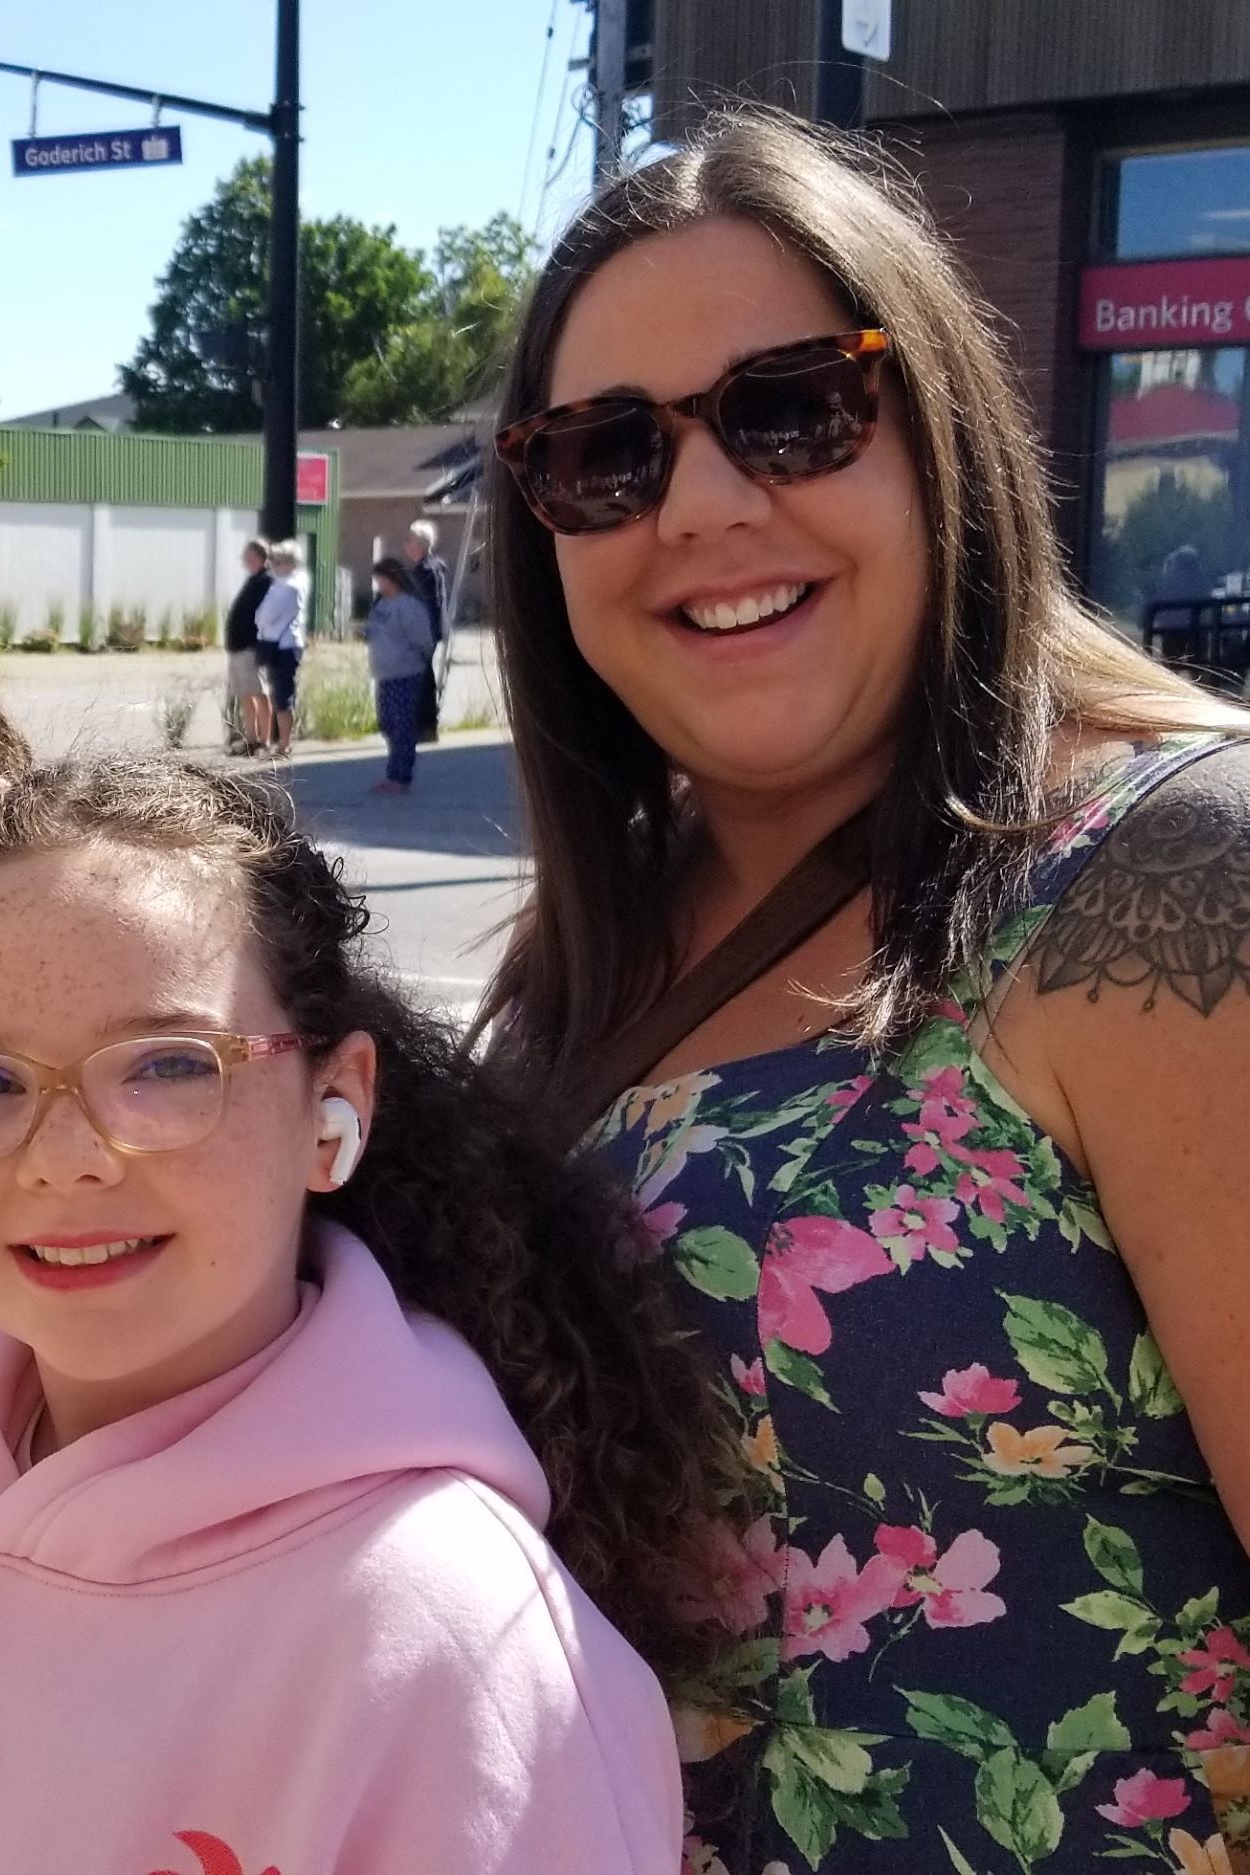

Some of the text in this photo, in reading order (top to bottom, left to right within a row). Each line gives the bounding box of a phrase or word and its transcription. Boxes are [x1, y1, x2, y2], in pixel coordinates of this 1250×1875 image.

[25, 140, 131, 167] Goderich St
[1096, 295, 1234, 333] Banking
